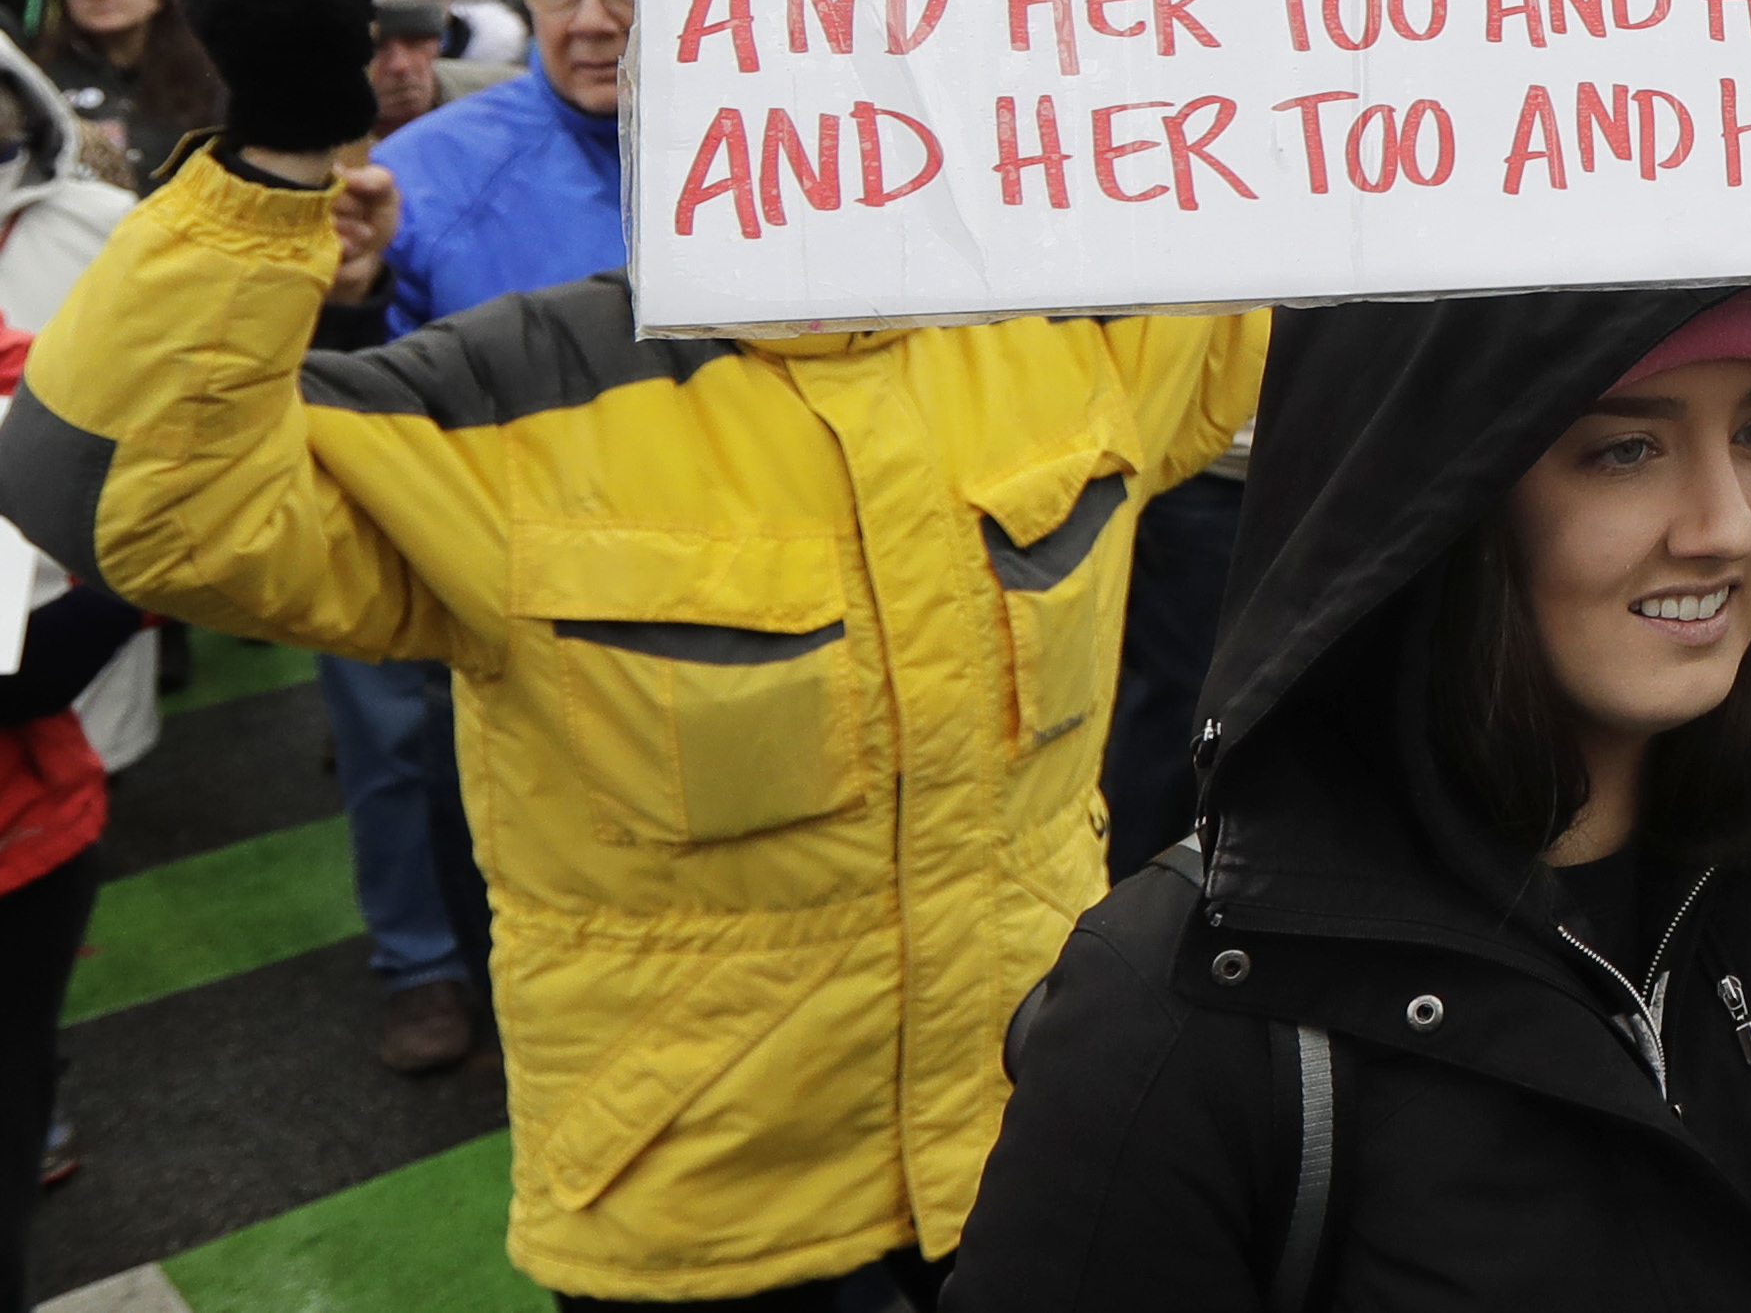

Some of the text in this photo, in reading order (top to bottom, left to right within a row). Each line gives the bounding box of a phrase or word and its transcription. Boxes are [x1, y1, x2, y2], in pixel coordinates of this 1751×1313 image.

[674, 101, 943, 239] AND
[992, 93, 1259, 211] HER
[1271, 91, 1455, 194] TOO
[1503, 81, 1694, 195] AND
